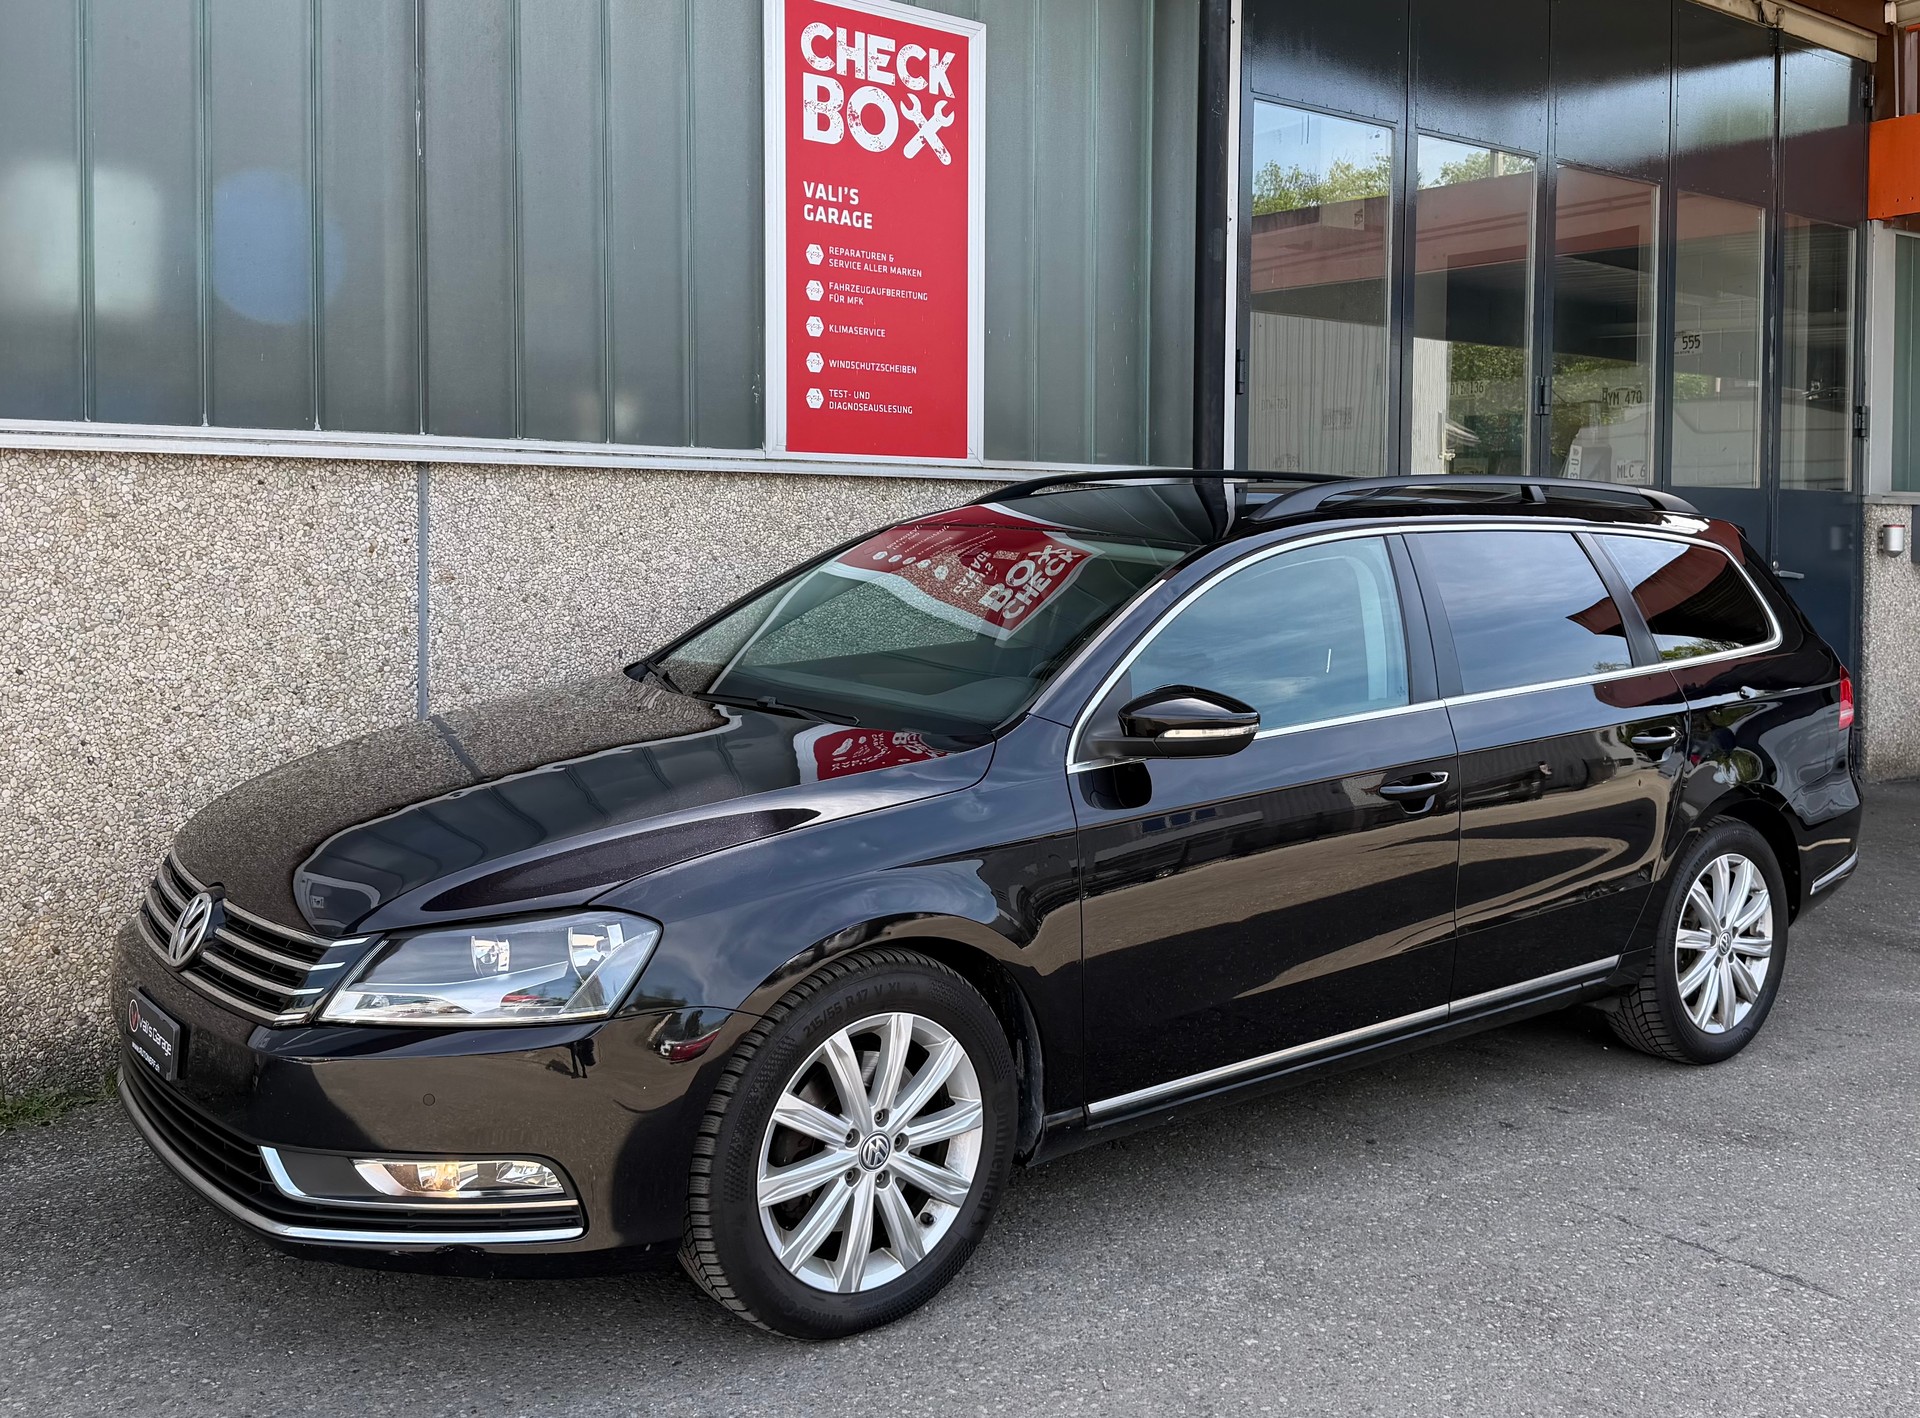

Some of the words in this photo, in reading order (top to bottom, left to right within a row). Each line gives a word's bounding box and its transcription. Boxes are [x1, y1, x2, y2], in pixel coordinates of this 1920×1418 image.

[801, 22, 955, 98] CHECK
[803, 72, 955, 165] BOX
[803, 181, 859, 205] VALI'S
[803, 204, 873, 229] GARAGE
[829, 246, 887, 261] REPARATUREN
[889, 254, 894, 262] &
[829, 258, 862, 271] SERVICE
[863, 263, 888, 274] ALLER
[890, 266, 922, 278] MARKEN
[829, 282, 928, 301] FAHRZEUGAUFBEREITUNG
[829, 293, 845, 304] FÜR
[847, 295, 864, 305] MFK
[829, 324, 886, 337] KLIMASERVICE
[1682, 334, 1701, 351] 555
[829, 359, 917, 374] WINDSCHUTZSCHEIBEN
[829, 389, 851, 399] TEST-
[853, 390, 870, 400] UND
[1625, 389, 1642, 404] 470
[829, 401, 913, 414] DIAGNOSEAUSLESUNG
[803, 1002, 843, 1037] 215/55
